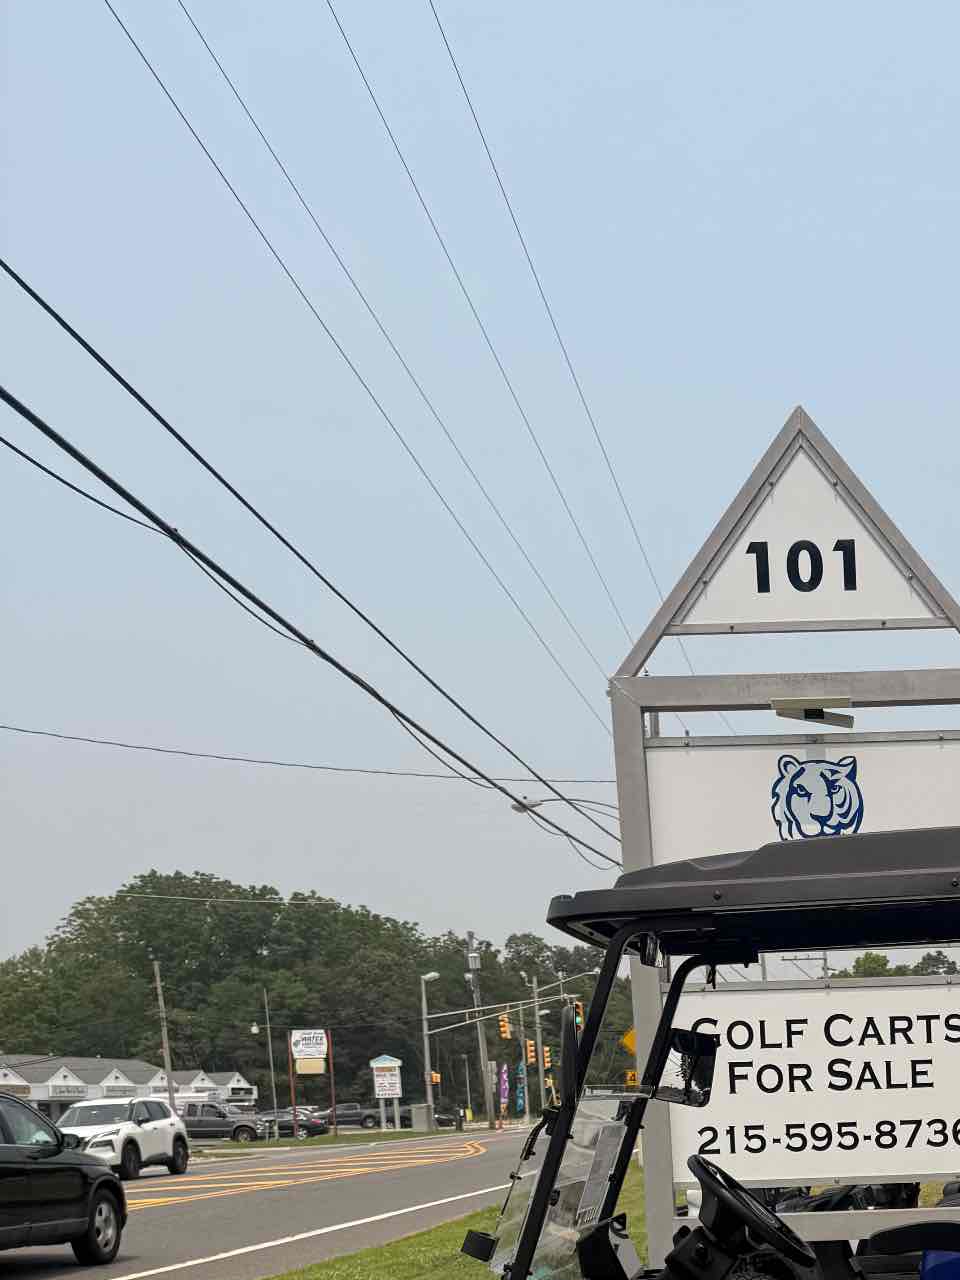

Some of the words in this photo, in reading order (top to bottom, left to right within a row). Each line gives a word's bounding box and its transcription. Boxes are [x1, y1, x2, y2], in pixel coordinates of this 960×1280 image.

[745, 539, 857, 593] 101
[727, 1060, 814, 1094] FOR
[827, 1058, 934, 1091] SALE
